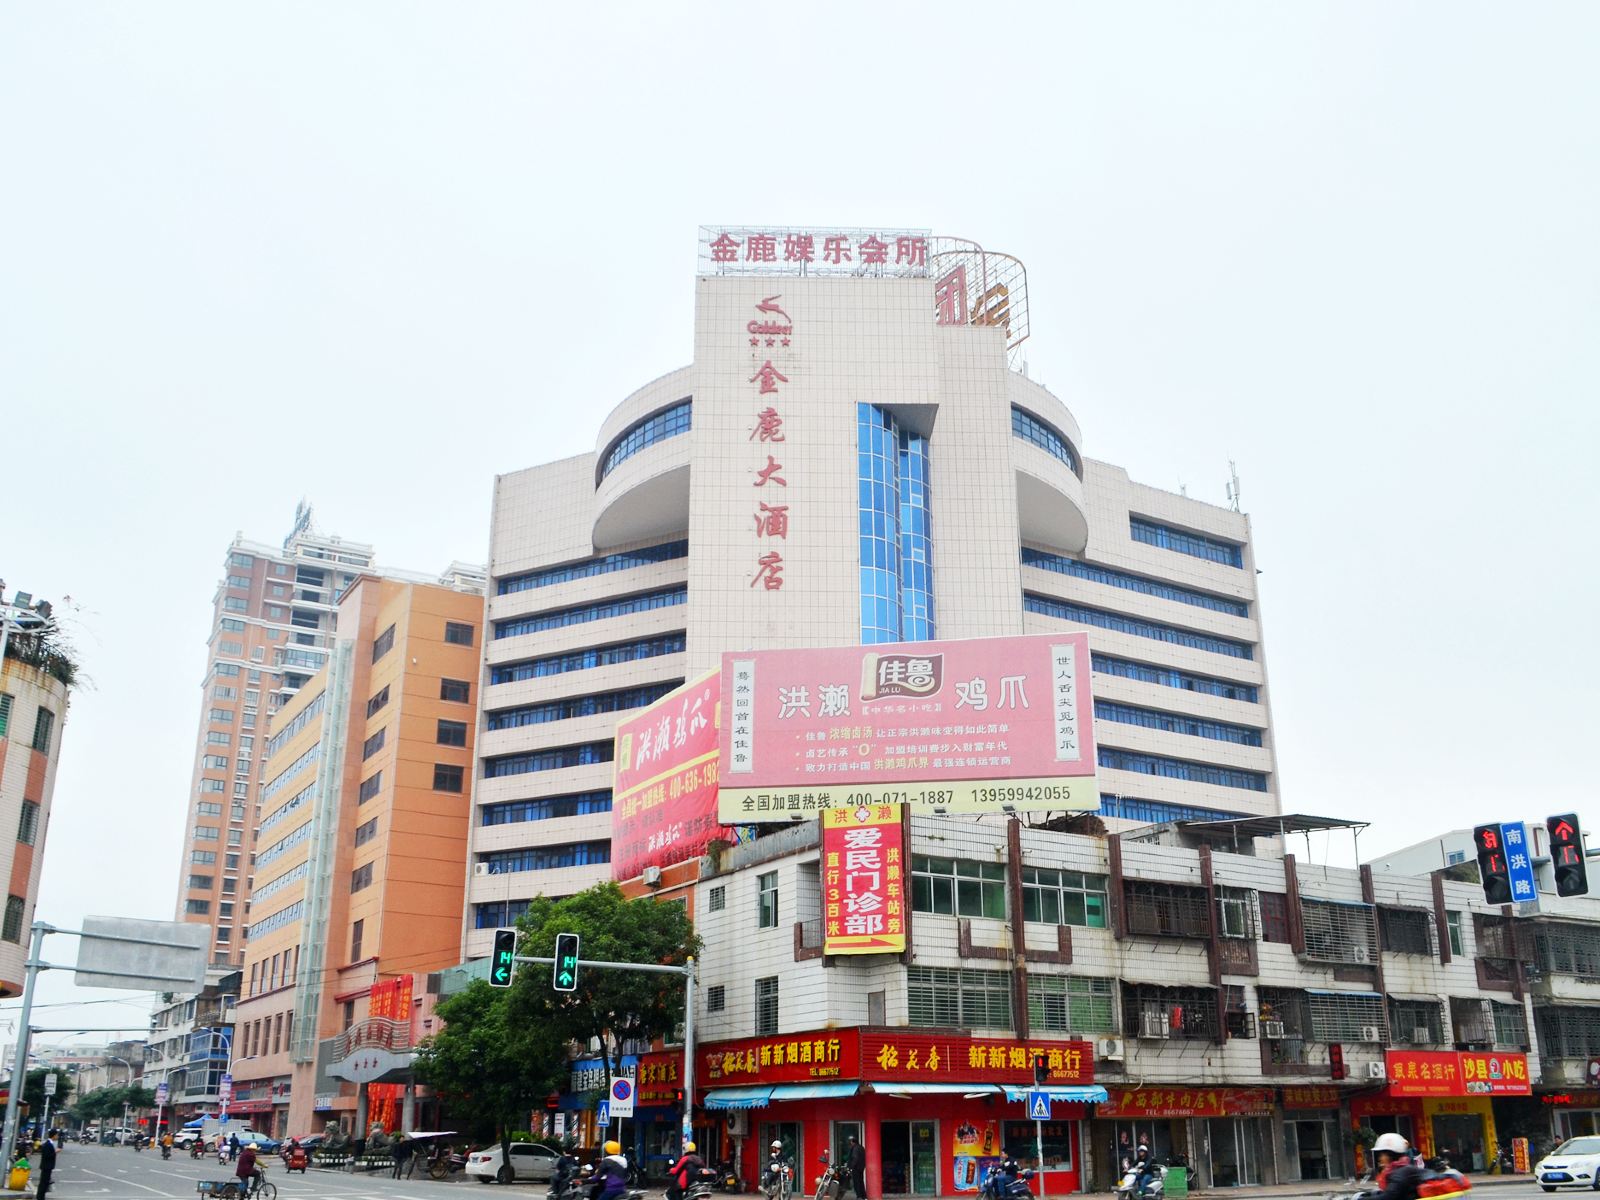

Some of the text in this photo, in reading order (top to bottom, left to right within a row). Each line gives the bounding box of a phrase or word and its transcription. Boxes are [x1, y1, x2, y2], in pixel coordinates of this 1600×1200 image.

[709, 232, 927, 267] 金鹿娱乐会所
[749, 360, 789, 591] 金鹿大酒店
[878, 659, 935, 692] 佳鲁
[777, 675, 1030, 719] 洪濑 鸡爪
[845, 789, 954, 807] 400-071-1887
[970, 786, 1071, 803] 13959942055
[843, 827, 883, 935] 爱民门诊部
[1506, 829, 1531, 895] 南洪路
[827, 852, 840, 936] 直行3百米
[886, 848, 901, 934] 洪濑车站旁
[760, 1039, 840, 1066] 新新烟酒商行
[968, 1045, 1081, 1070] 新新烟酒商行
[1463, 1058, 1526, 1080] 沙县 小吃
